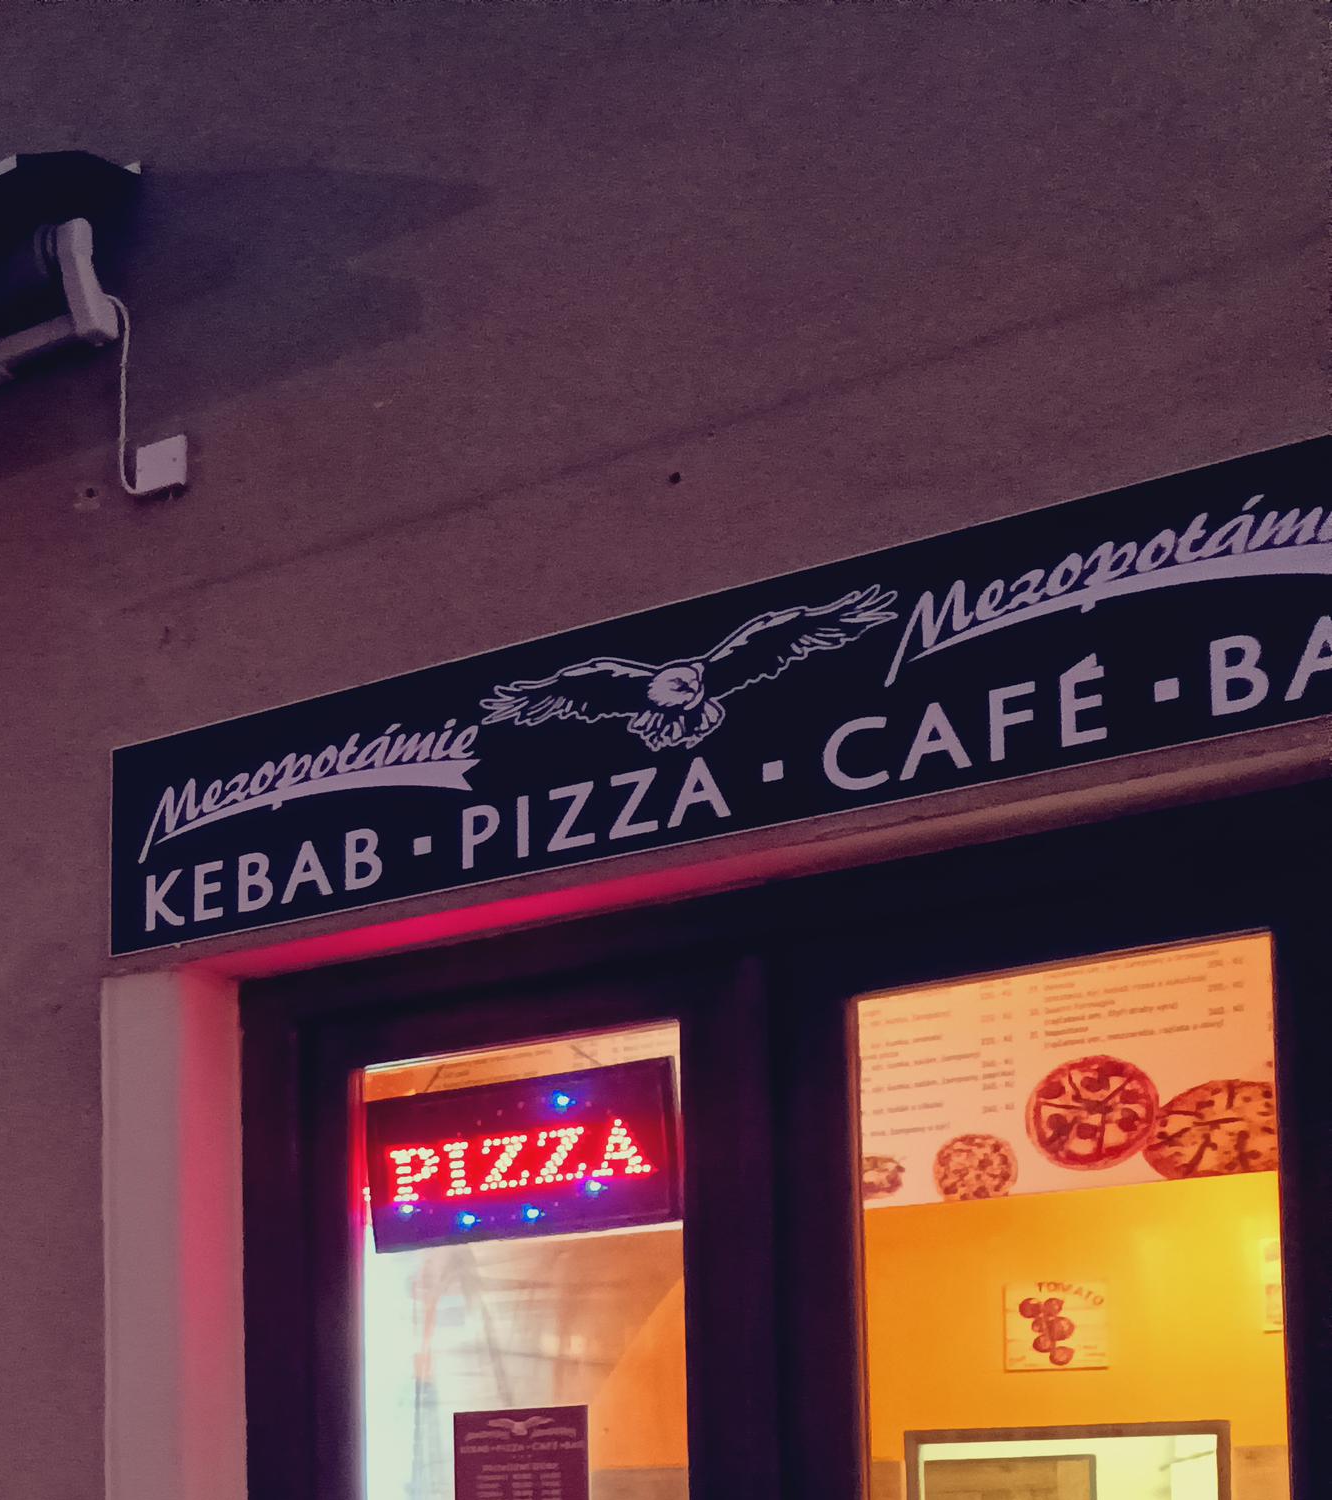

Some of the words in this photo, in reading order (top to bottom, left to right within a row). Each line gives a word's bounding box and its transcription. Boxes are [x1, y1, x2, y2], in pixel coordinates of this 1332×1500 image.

[885, 493, 1332, 688] Mezopotám
[138, 719, 482, 865] Mezopotámie
[144, 828, 384, 912] KEBAB
[461, 756, 733, 870] PIZZA
[821, 652, 1109, 792] CAFÉ
[389, 1118, 652, 1202] PIZZA
